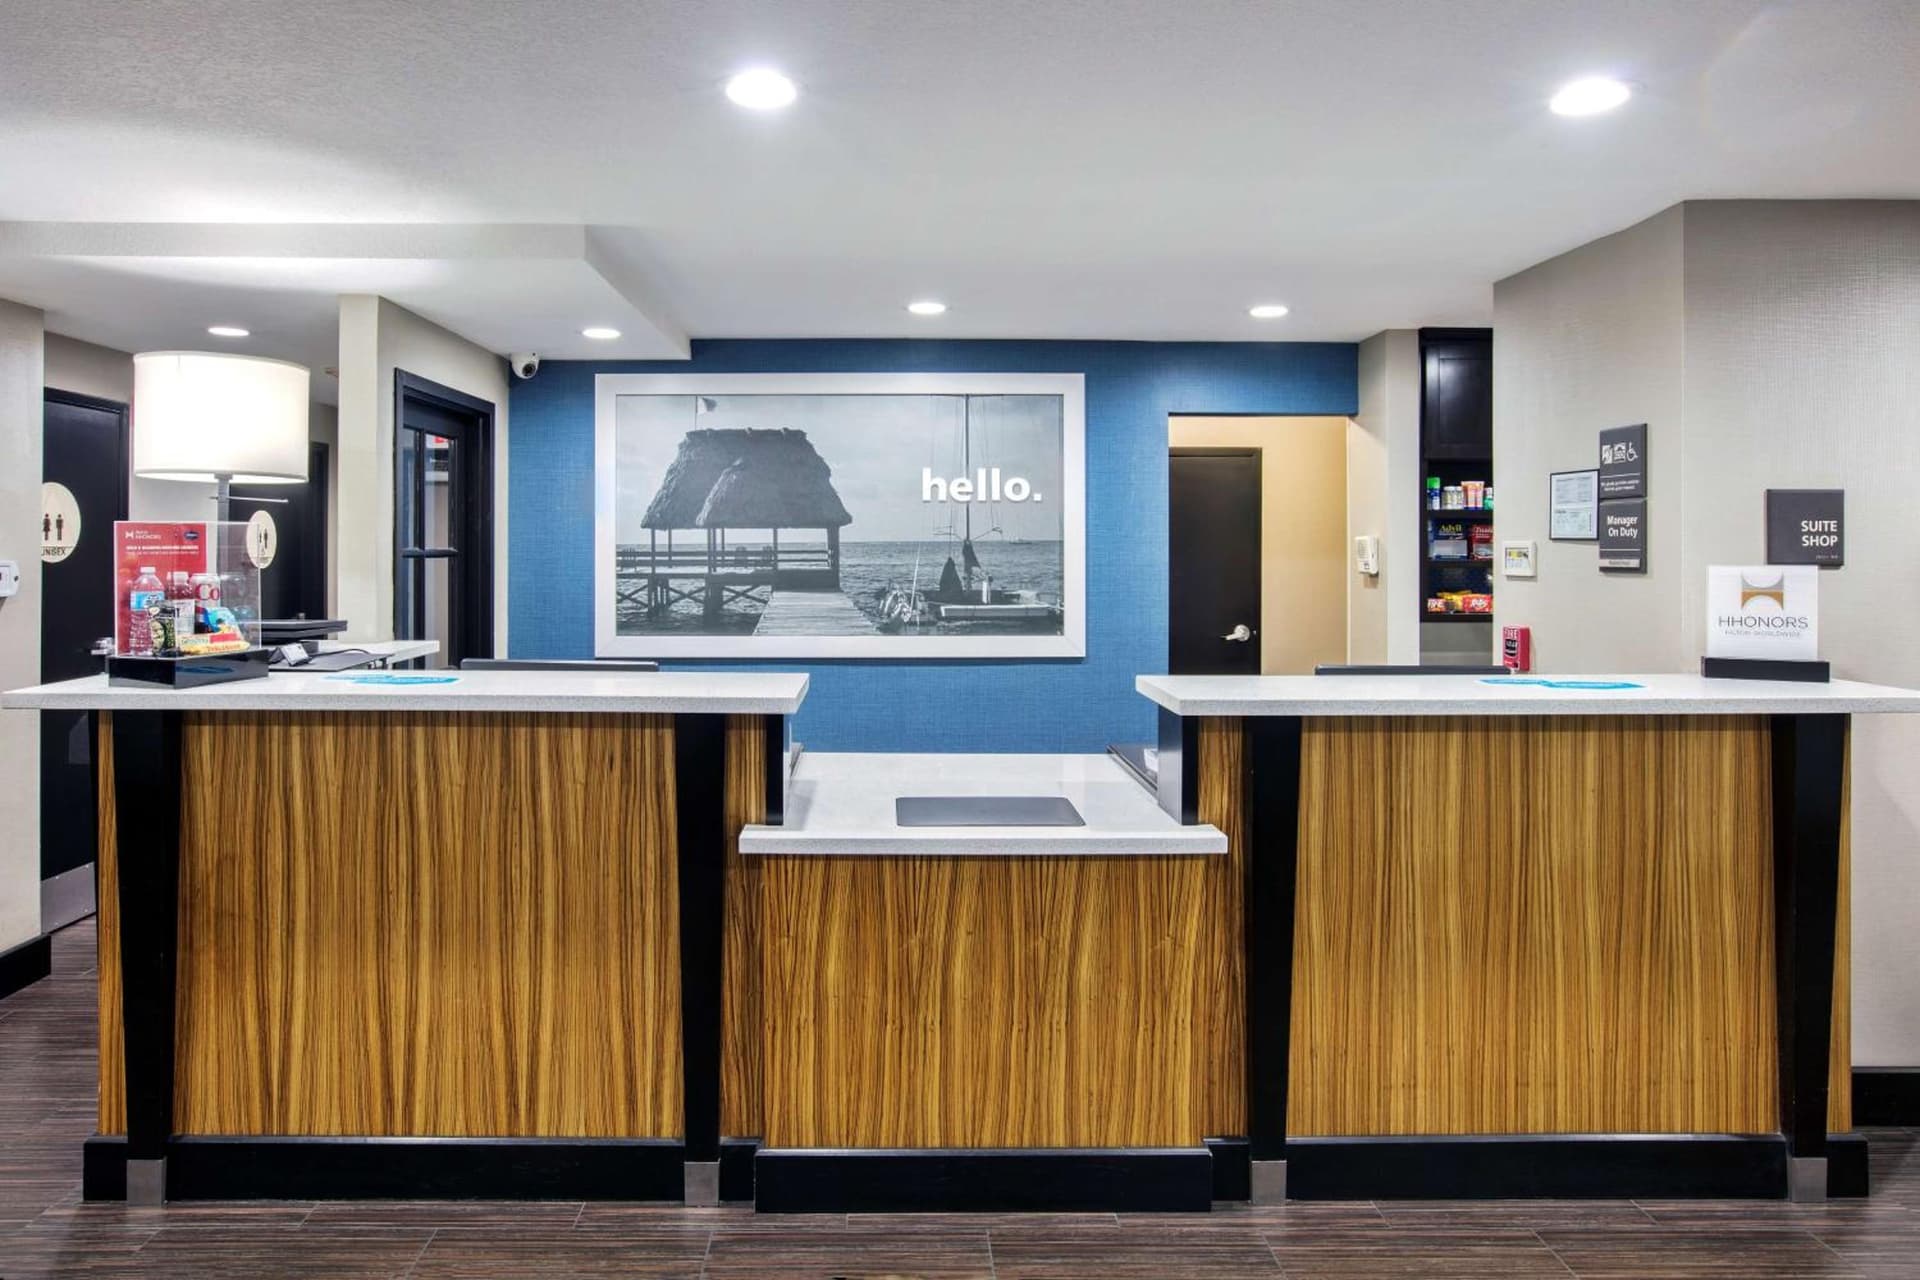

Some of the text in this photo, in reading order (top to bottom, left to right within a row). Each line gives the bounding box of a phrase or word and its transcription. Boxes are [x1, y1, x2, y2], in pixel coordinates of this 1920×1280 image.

[922, 467, 1042, 502] hello.
[1607, 516, 1638, 527] Manager
[1801, 520, 1838, 532] SUITE
[1441, 524, 1462, 533] Advil
[1608, 527, 1638, 539] On Duty
[1801, 535, 1838, 547] SHOP
[1718, 615, 1809, 629] HHONORS
